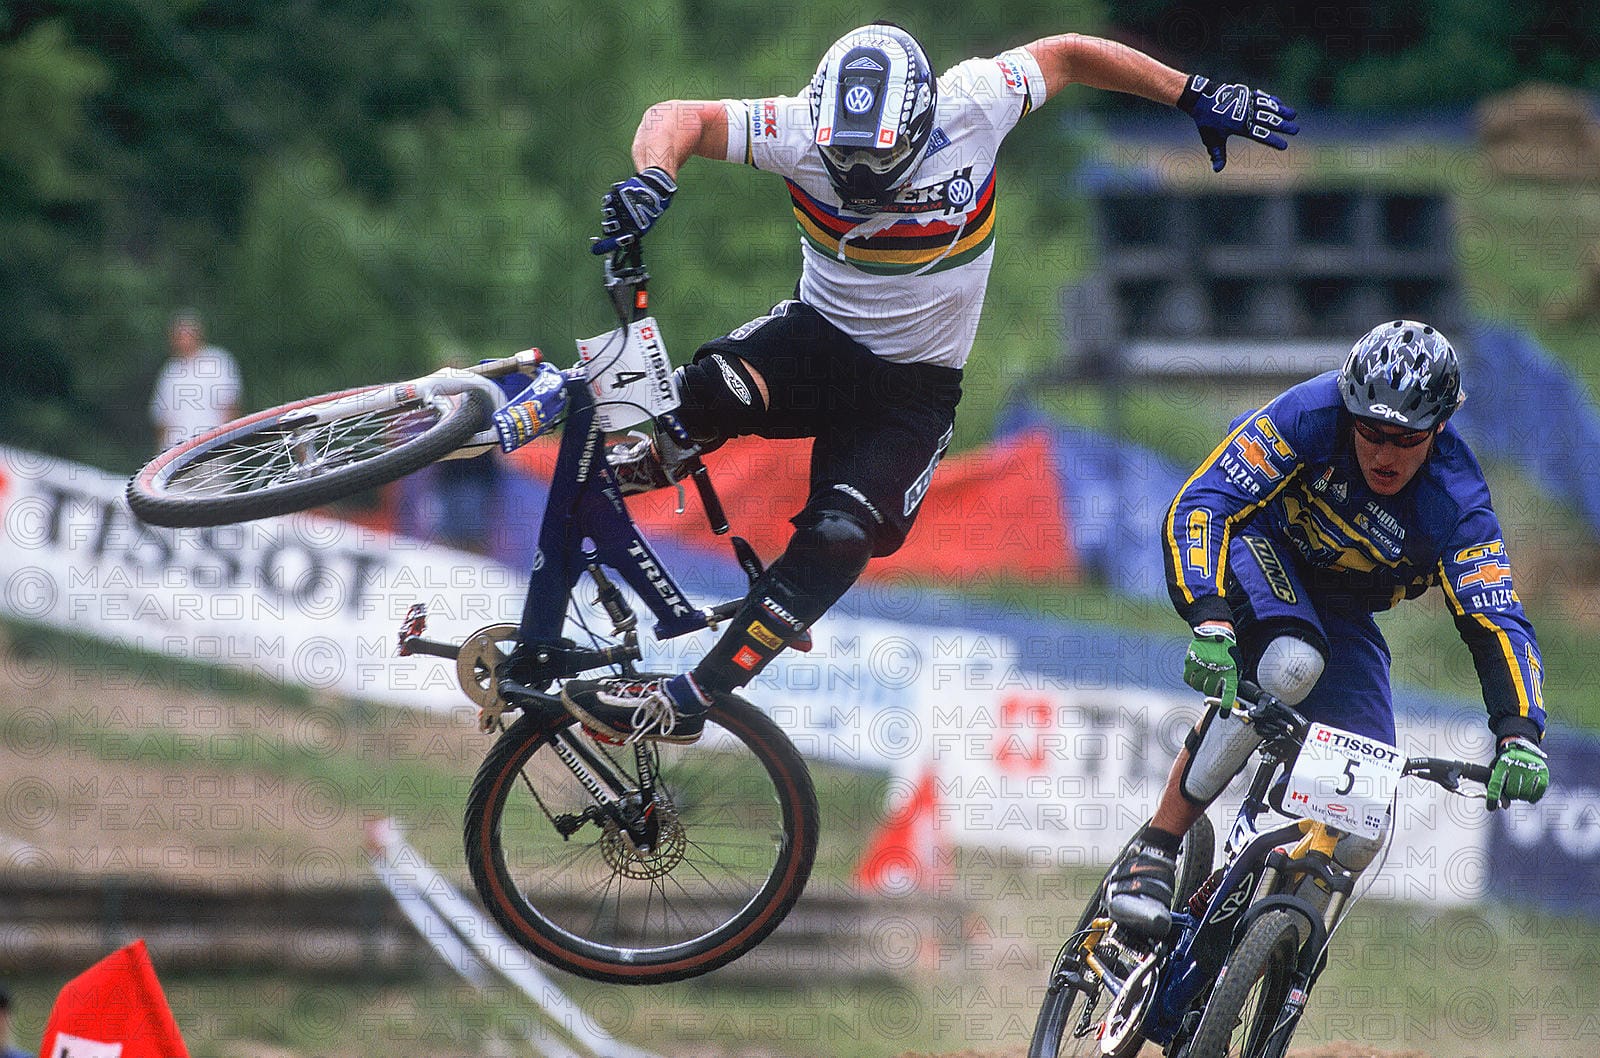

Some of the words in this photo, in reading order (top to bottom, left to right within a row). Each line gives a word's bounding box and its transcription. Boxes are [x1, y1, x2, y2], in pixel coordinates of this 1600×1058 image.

[611, 371, 647, 389] 4
[646, 339, 675, 401] TISSOT
[576, 414, 600, 482] olkswagen
[1219, 452, 1261, 496] BLAZER
[627, 539, 690, 618] TREK
[1472, 588, 1515, 609] BLAZE
[1333, 734, 1399, 763] TISSOT
[556, 740, 610, 806] SHIMANO
[1335, 759, 1361, 796] 5
